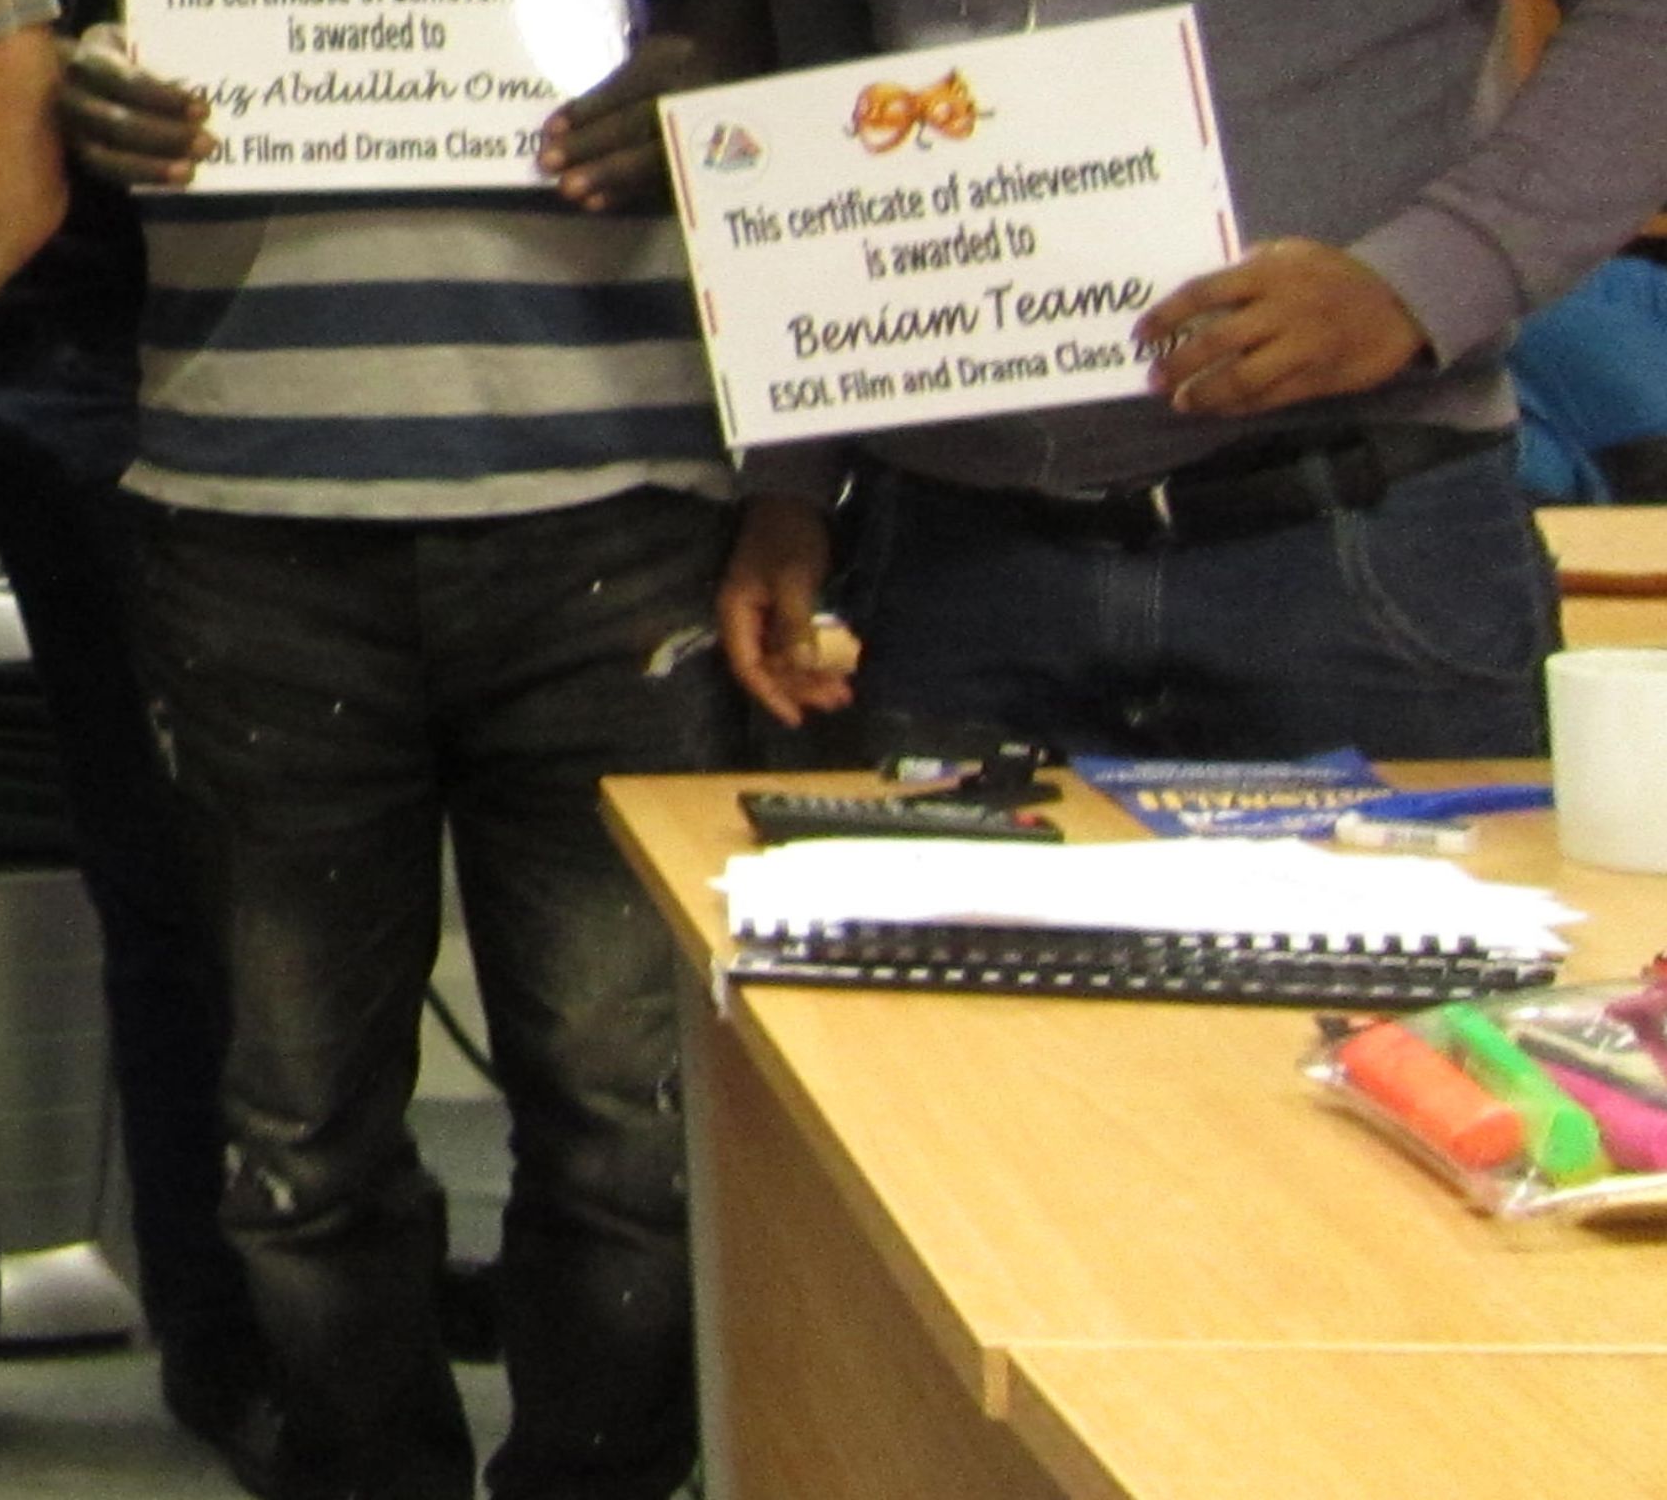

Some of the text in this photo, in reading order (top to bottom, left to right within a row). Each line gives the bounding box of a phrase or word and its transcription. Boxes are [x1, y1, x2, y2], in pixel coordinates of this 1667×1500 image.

[287, 11, 447, 53] is awarded to
[260, 69, 459, 108] Abdullah
[242, 133, 295, 165] Film
[301, 129, 347, 162] and
[354, 129, 439, 161] Drama
[444, 129, 508, 160] Class
[514, 128, 543, 157] 20
[723, 145, 1162, 250] This certificate of achievement
[863, 218, 1036, 280] is awarded to
[787, 273, 1156, 360] Beniam Teame
[768, 377, 836, 414] ESOL
[838, 369, 896, 402] Film
[903, 359, 952, 395] and
[958, 346, 1049, 384] Drama
[1055, 336, 1126, 374] Class
